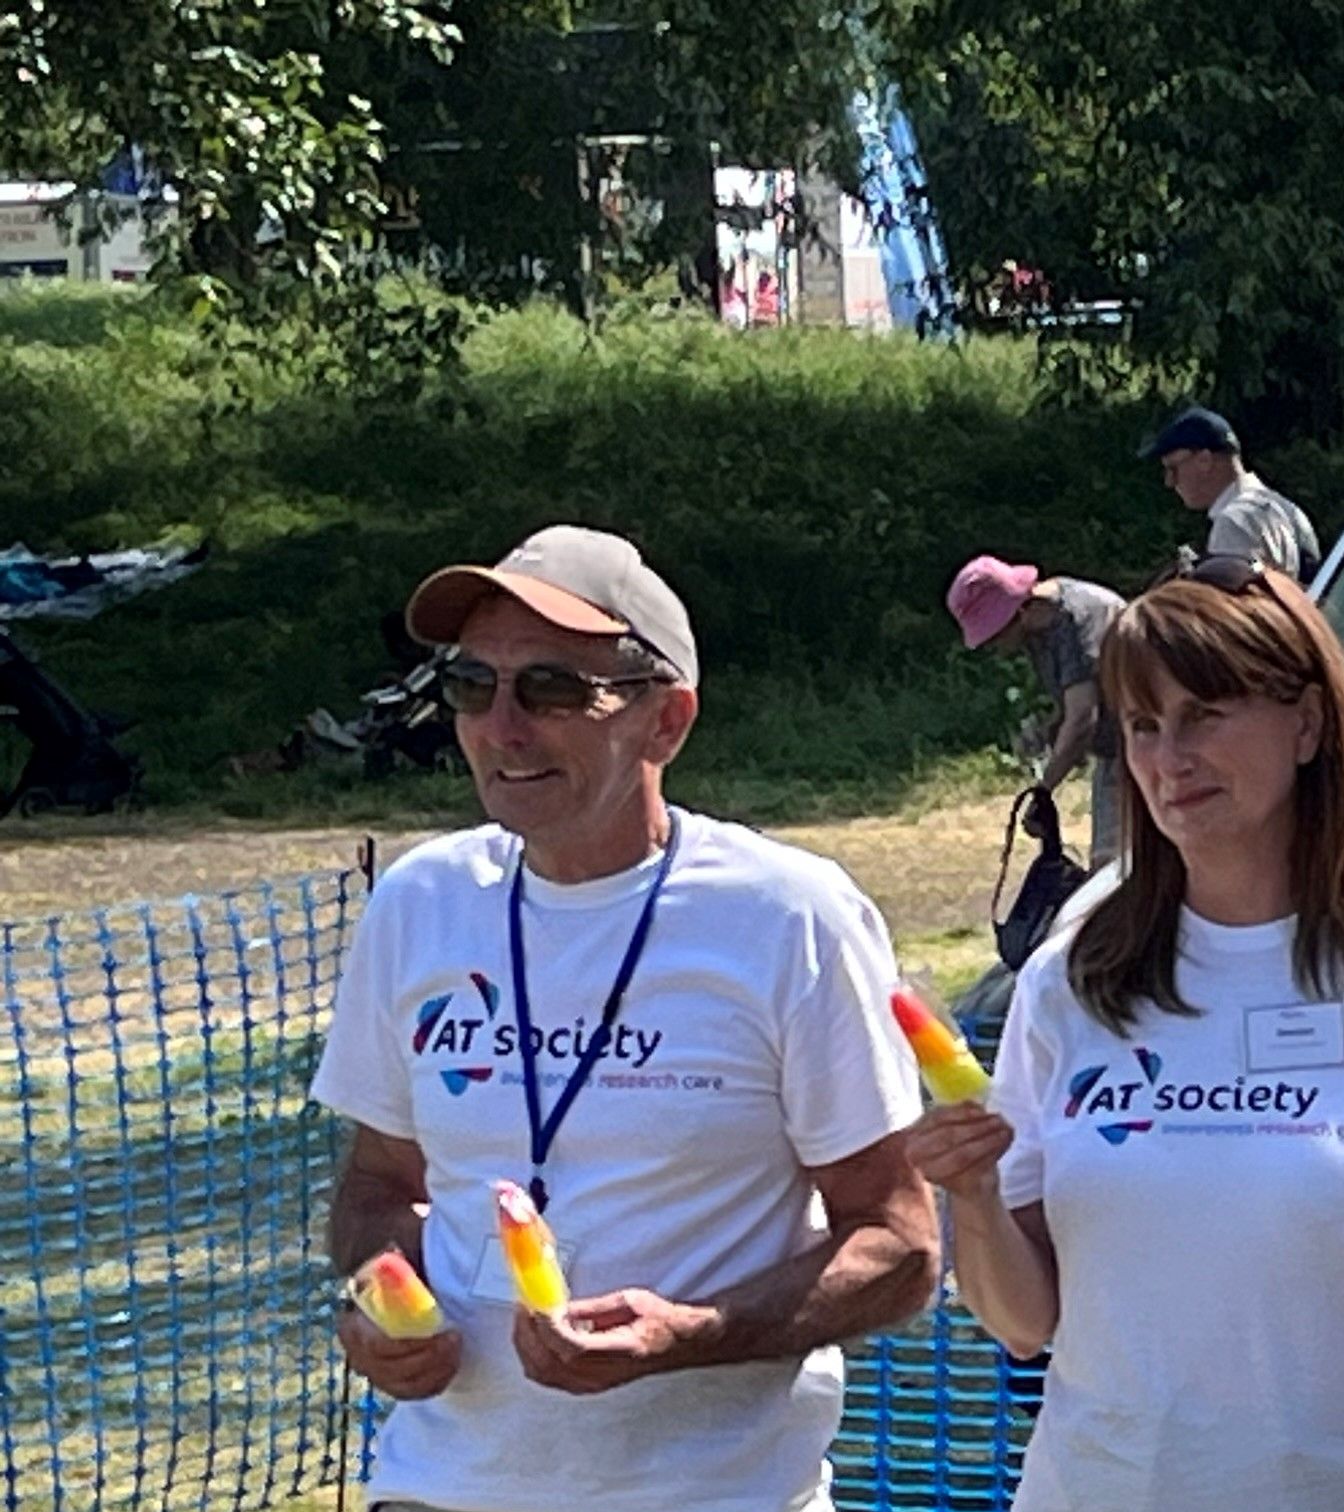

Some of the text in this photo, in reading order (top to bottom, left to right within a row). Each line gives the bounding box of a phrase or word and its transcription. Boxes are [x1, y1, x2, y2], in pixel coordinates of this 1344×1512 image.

[432, 1018, 484, 1055] AT
[681, 1073, 723, 1090] care
[1087, 1075, 1319, 1118] AT society
